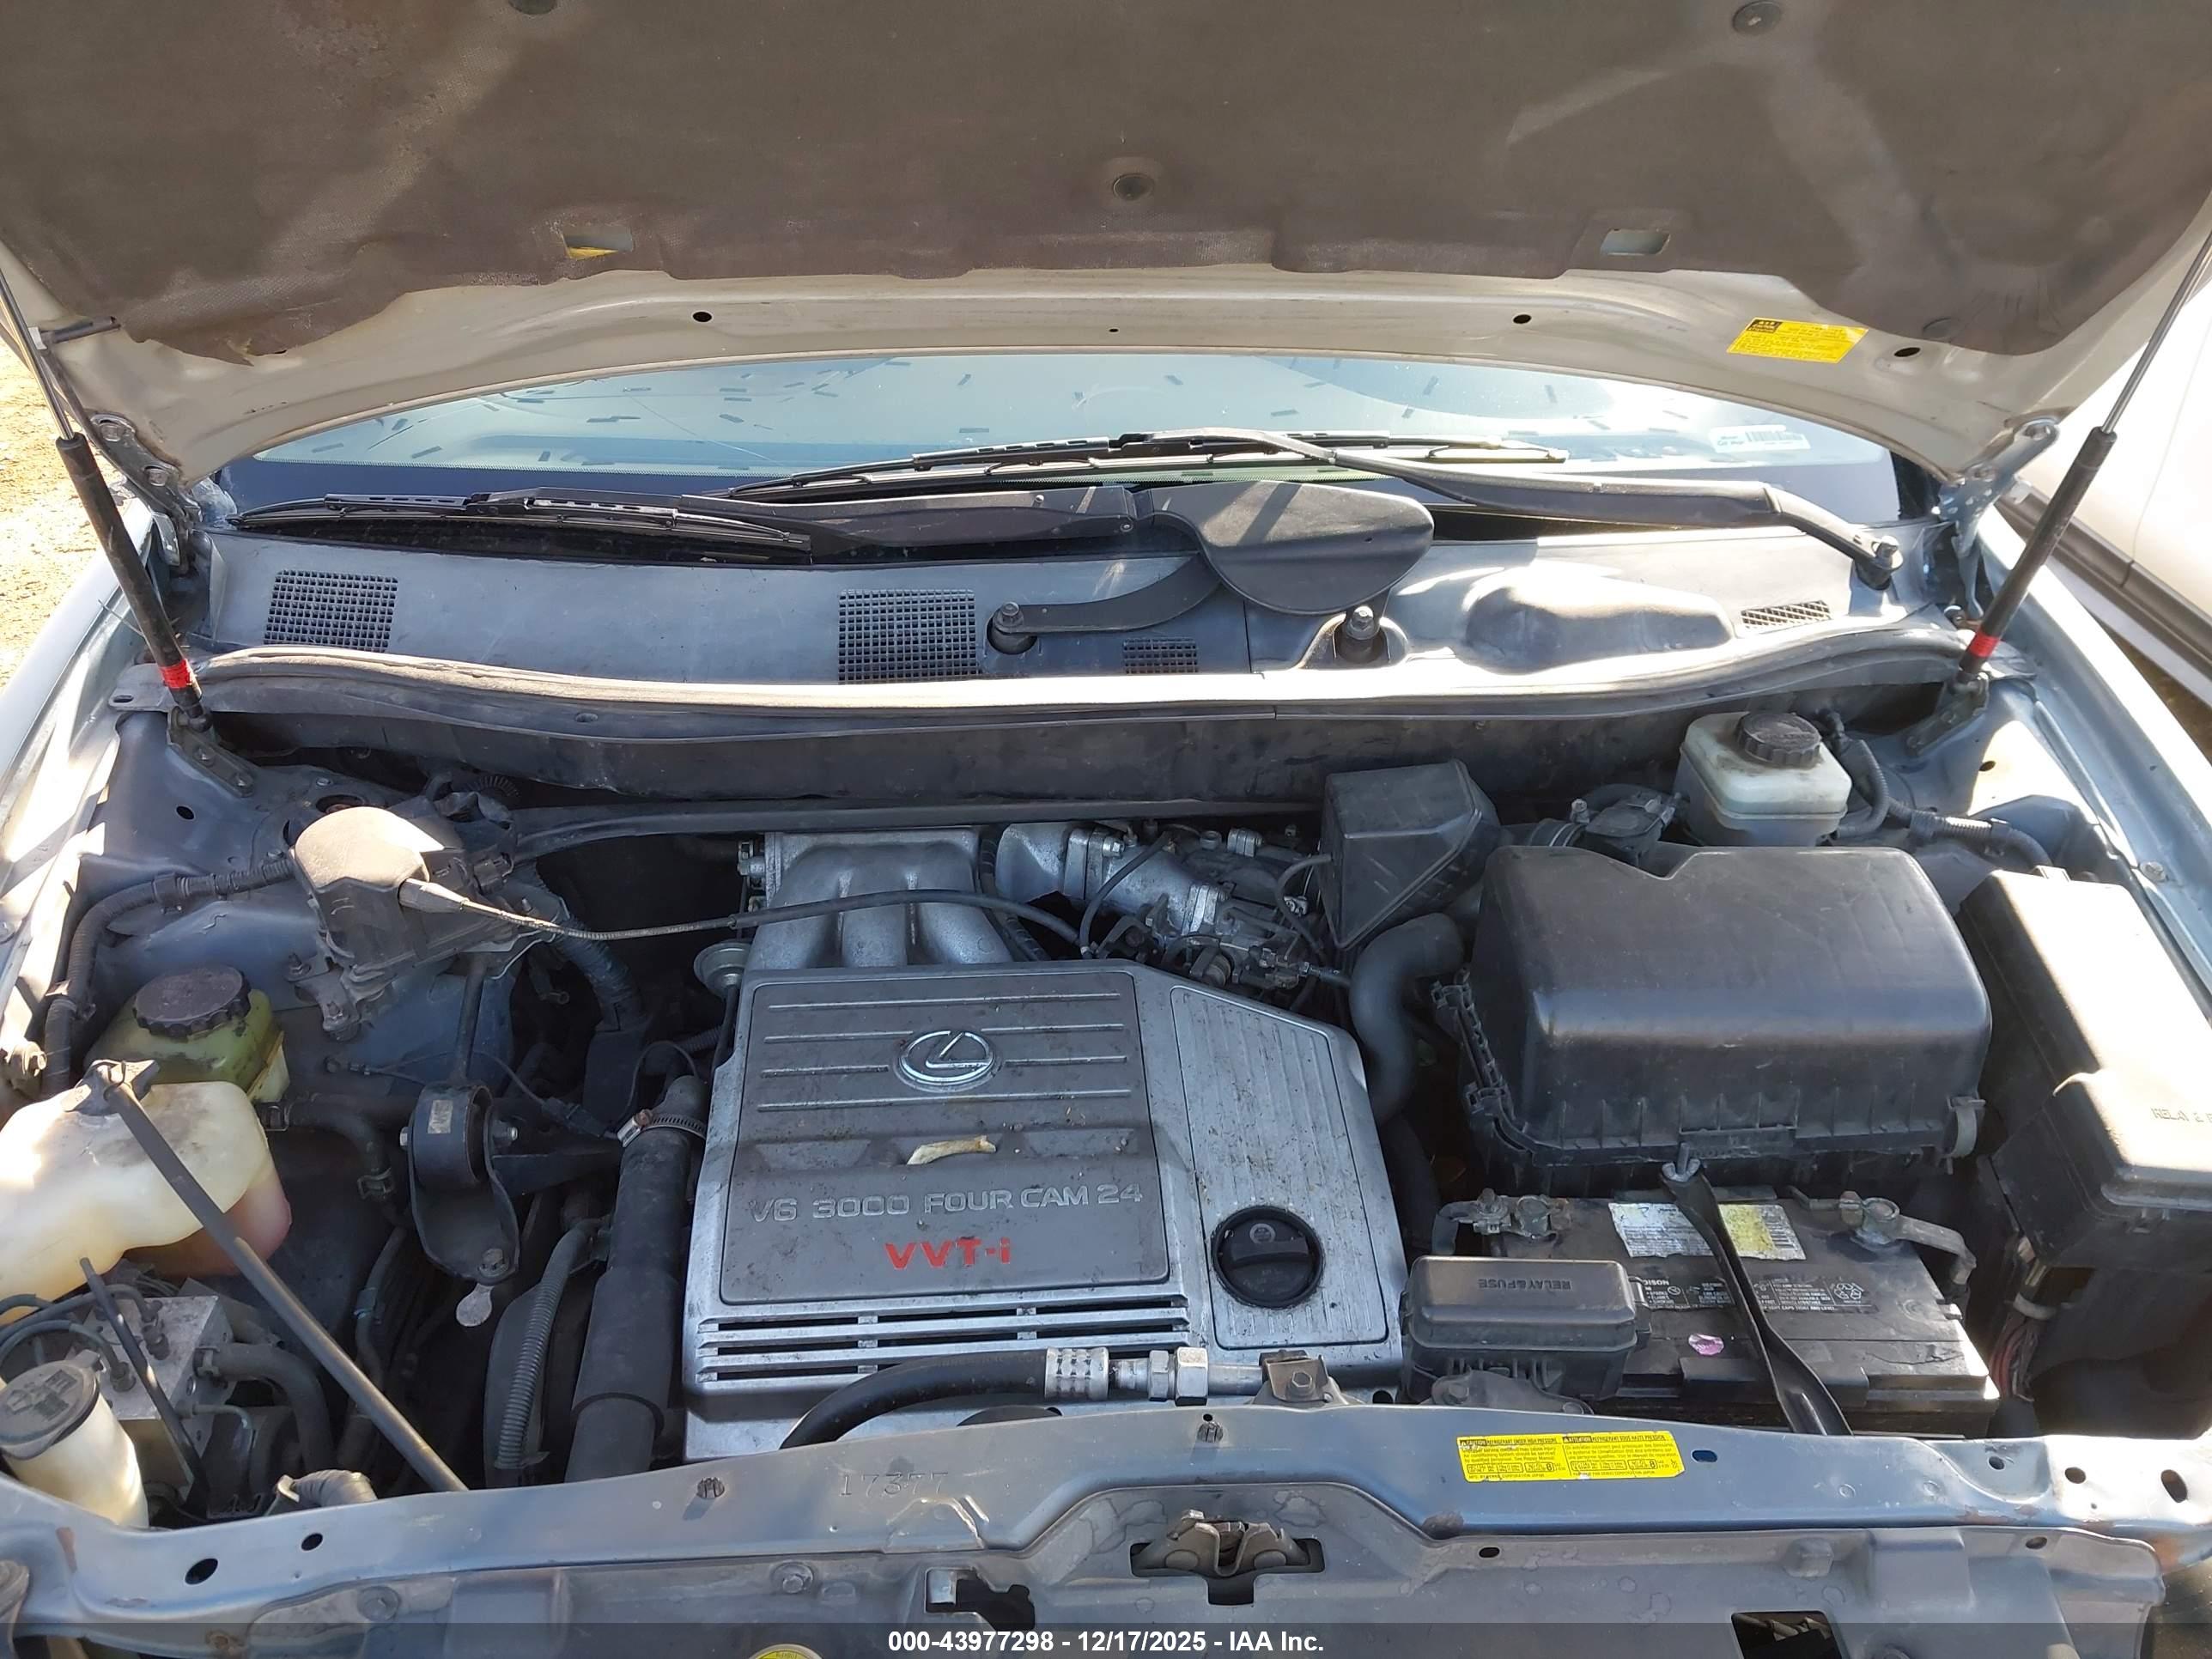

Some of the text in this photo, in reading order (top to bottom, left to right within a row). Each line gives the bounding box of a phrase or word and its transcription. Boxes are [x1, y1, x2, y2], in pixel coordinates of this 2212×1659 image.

[750, 1183, 1143, 1223] V6 3000 FOUR CAM 24
[884, 1237, 1011, 1270] VVT-i
[839, 1471, 949, 1498] 17377
